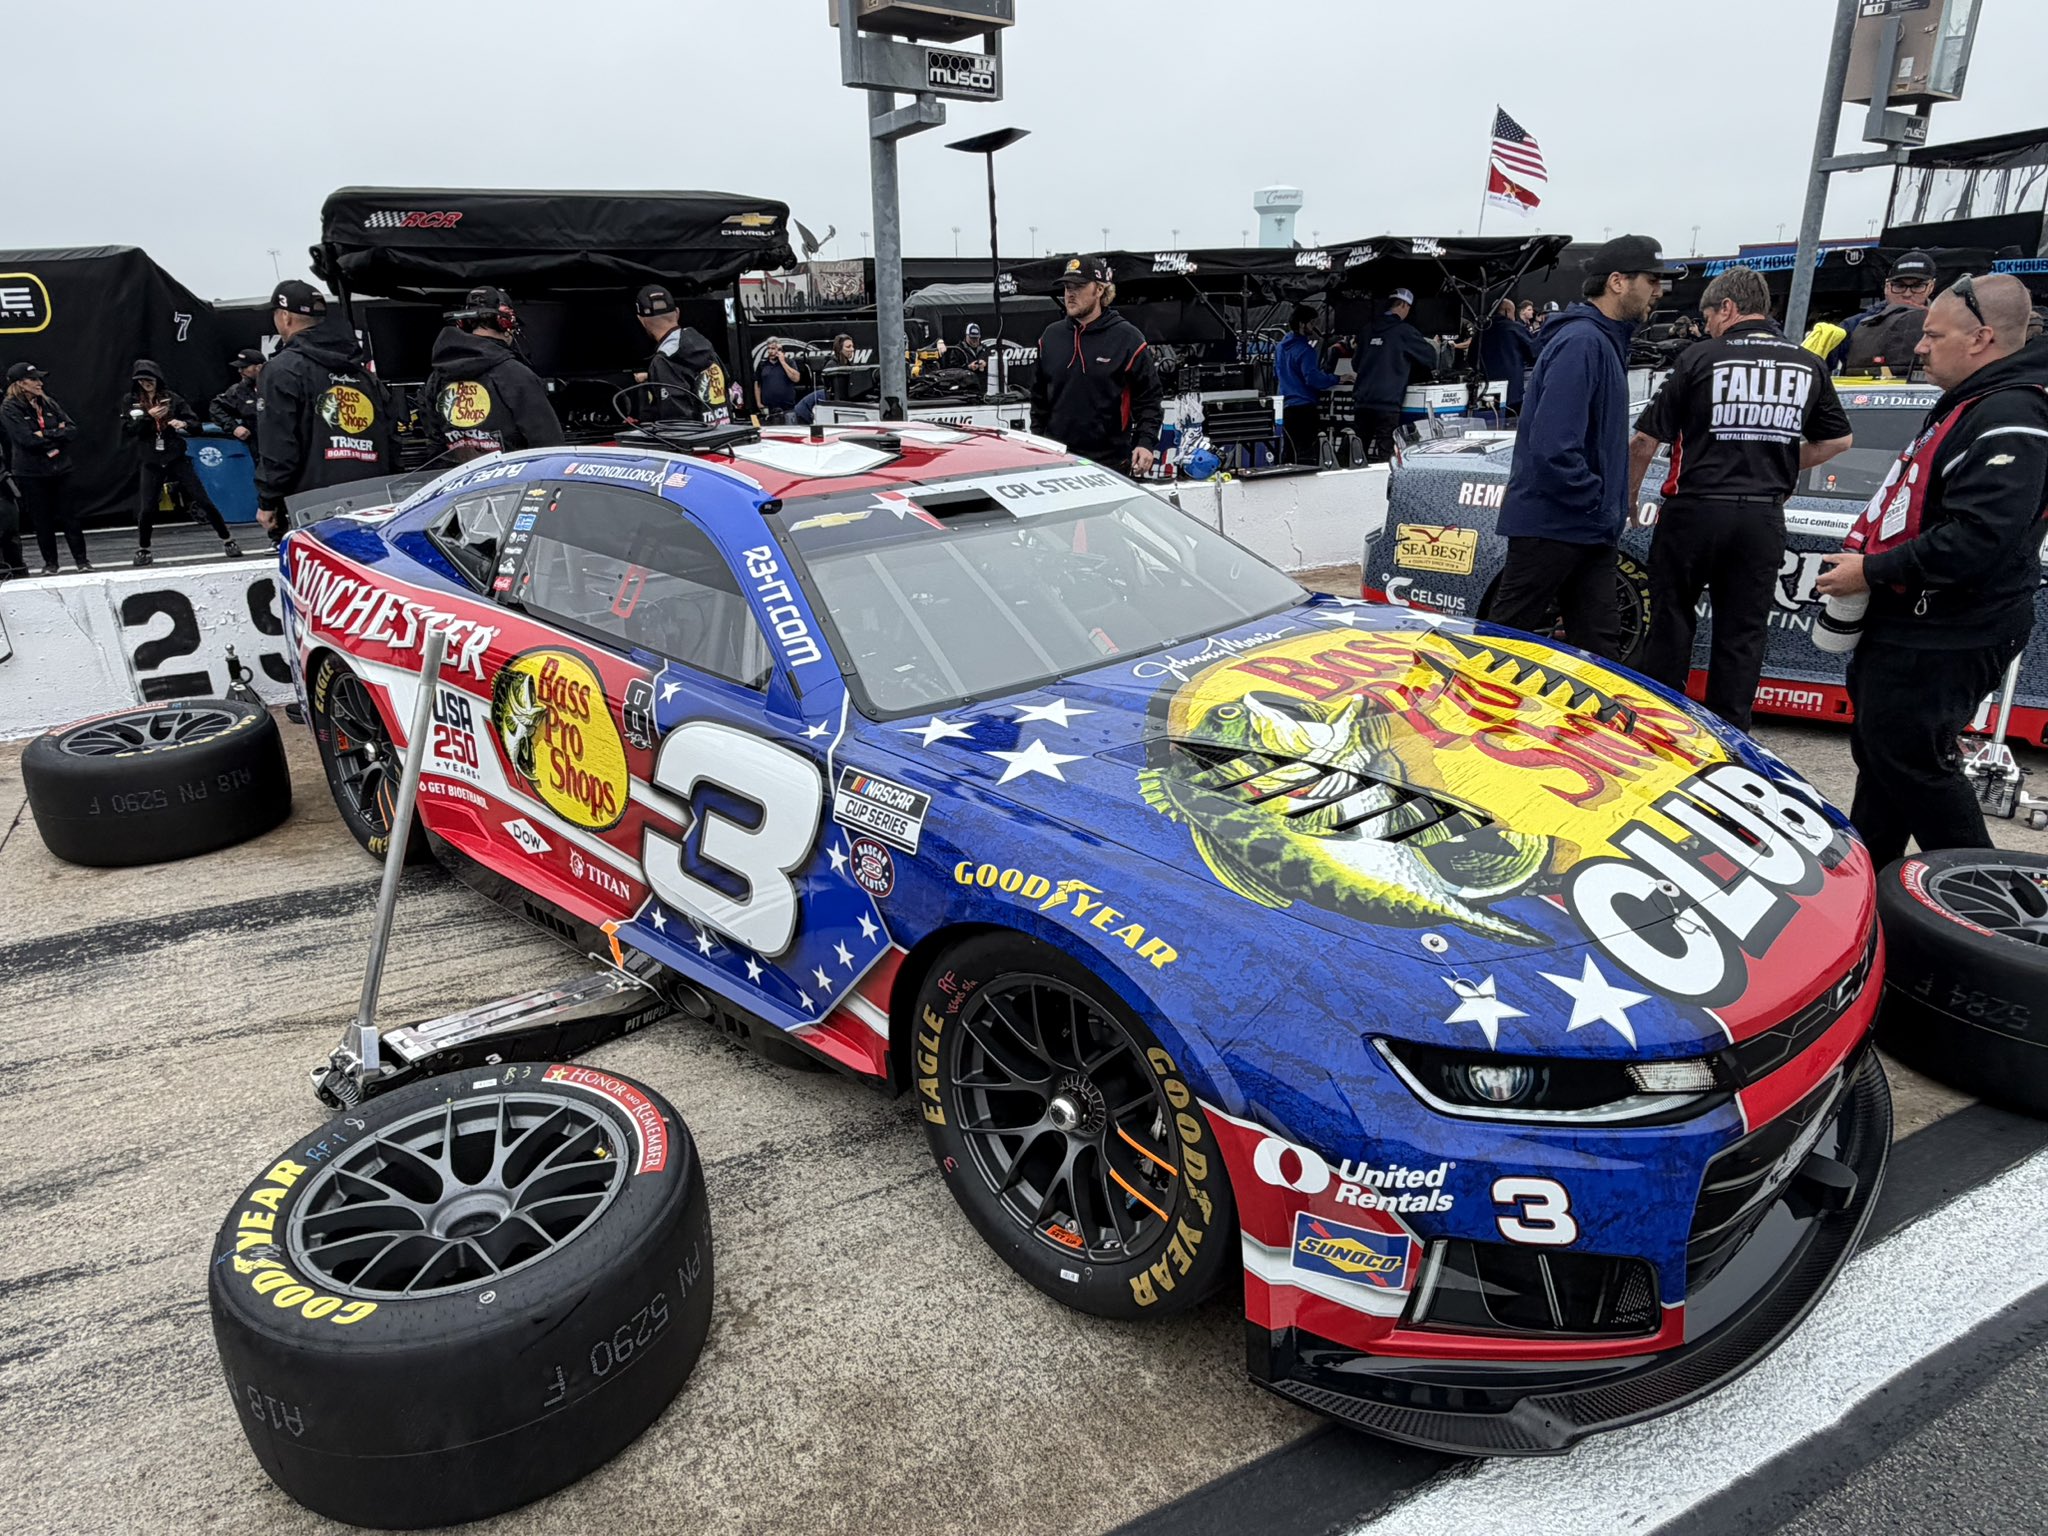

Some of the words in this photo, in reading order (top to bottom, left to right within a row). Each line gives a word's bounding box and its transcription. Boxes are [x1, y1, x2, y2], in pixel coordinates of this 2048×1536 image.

[174, 311, 192, 341] 7
[1757, 359, 1776, 368] THE
[336, 388, 359, 403] Bass
[456, 382, 478, 396] Bass
[456, 396, 474, 408] Pro
[1712, 367, 1812, 408] FALLEN
[1872, 395, 1888, 405] TY
[1890, 397, 1937, 406] DILLON
[340, 402, 356, 415] Pro
[343, 414, 368, 430] Shops
[456, 408, 486, 422] Shops
[1711, 403, 1803, 431] OUTDOORS
[996, 482, 1045, 499] CPL
[1458, 482, 1507, 508] REM
[1810, 518, 1849, 529] contains
[1401, 543, 1428, 556] SEA
[1430, 544, 1467, 562] BEST
[1410, 588, 1466, 611] CELSIUS
[295, 547, 495, 682] WINCHESTER
[537, 656, 591, 721] Bass
[433, 689, 474, 734] USA
[433, 724, 479, 770] 250
[544, 710, 584, 762] Pro
[444, 761, 477, 780] YEARS
[549, 748, 617, 821] Shops
[428, 782, 440, 795] GET
[864, 780, 915, 811] NASCAR
[844, 799, 869, 818] CUP
[867, 808, 908, 836] SERIES
[512, 823, 541, 850] DOW
[643, 721, 822, 957] 3
[856, 843, 888, 867] NASCAR
[862, 860, 881, 874] 250
[586, 863, 631, 901] TITAN
[855, 867, 888, 892] SALUTES
[1572, 766, 1834, 996] CLUB
[954, 861, 1178, 969] GOODYEAR
[938, 970, 957, 994] RF
[625, 1014, 642, 1032] PIT
[643, 1003, 671, 1024] VIPER
[919, 1003, 947, 1126] EAGLE
[569, 1068, 627, 1097] HONOR
[624, 1093, 640, 1105] AND
[631, 1102, 665, 1171] REMEMBER
[1129, 1046, 1214, 1307] GOODYEAR
[1336, 1158, 1448, 1189] United
[1335, 1184, 1455, 1213] Rentals
[1492, 1177, 1577, 1246] 3
[233, 1159, 378, 1324] GOODYEAR
[1300, 1236, 1403, 1274] SUNOCO
[591, 1292, 669, 1377] 5290
[543, 1364, 566, 1408] F
